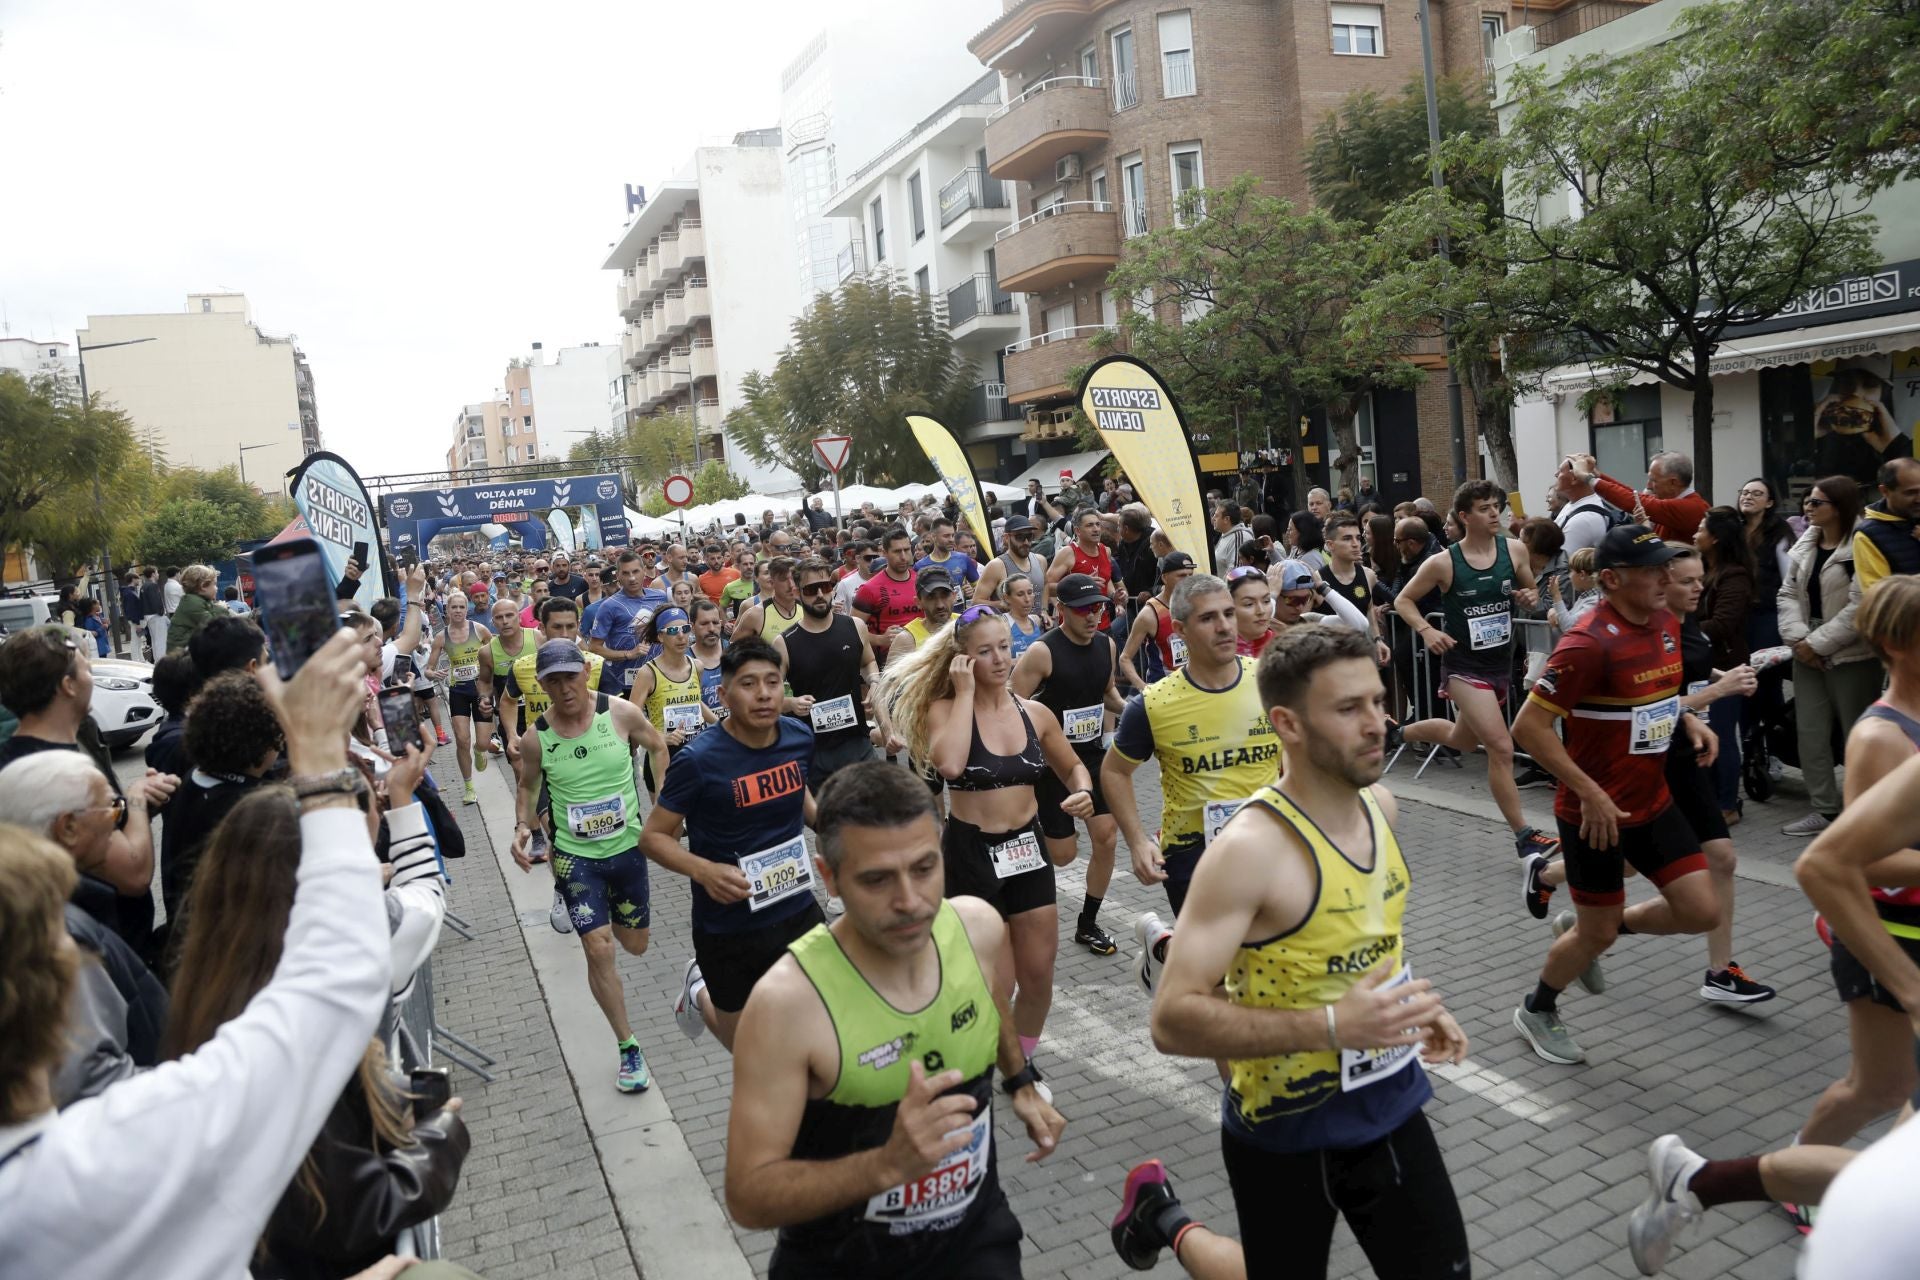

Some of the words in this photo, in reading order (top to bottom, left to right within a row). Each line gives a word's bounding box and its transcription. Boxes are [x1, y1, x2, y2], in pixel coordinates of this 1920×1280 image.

[625, 183, 646, 213] H
[1755, 351, 1811, 367] PASTELERÍA
[1821, 342, 1878, 358] CAFETERÍA
[475, 490, 507, 500] VOLTA
[517, 488, 536, 497] PEU
[489, 499, 525, 509] DÉNIA
[1482, 629, 1502, 640] 1076
[666, 694, 699, 705] BALEARIA
[826, 712, 842, 723] 645
[1076, 721, 1096, 734] 1182
[1640, 730, 1647, 739] B
[740, 780, 751, 804] I
[757, 763, 801, 799] RUN
[586, 816, 613, 830] 1360
[1006, 844, 1032, 861] 3345
[754, 880, 763, 891] B
[766, 866, 795, 888] 1209
[767, 879, 798, 897] BALEARIA
[886, 1191, 900, 1208] B
[909, 1165, 967, 1205] 1389
[904, 1186, 967, 1216] BALEARIA
